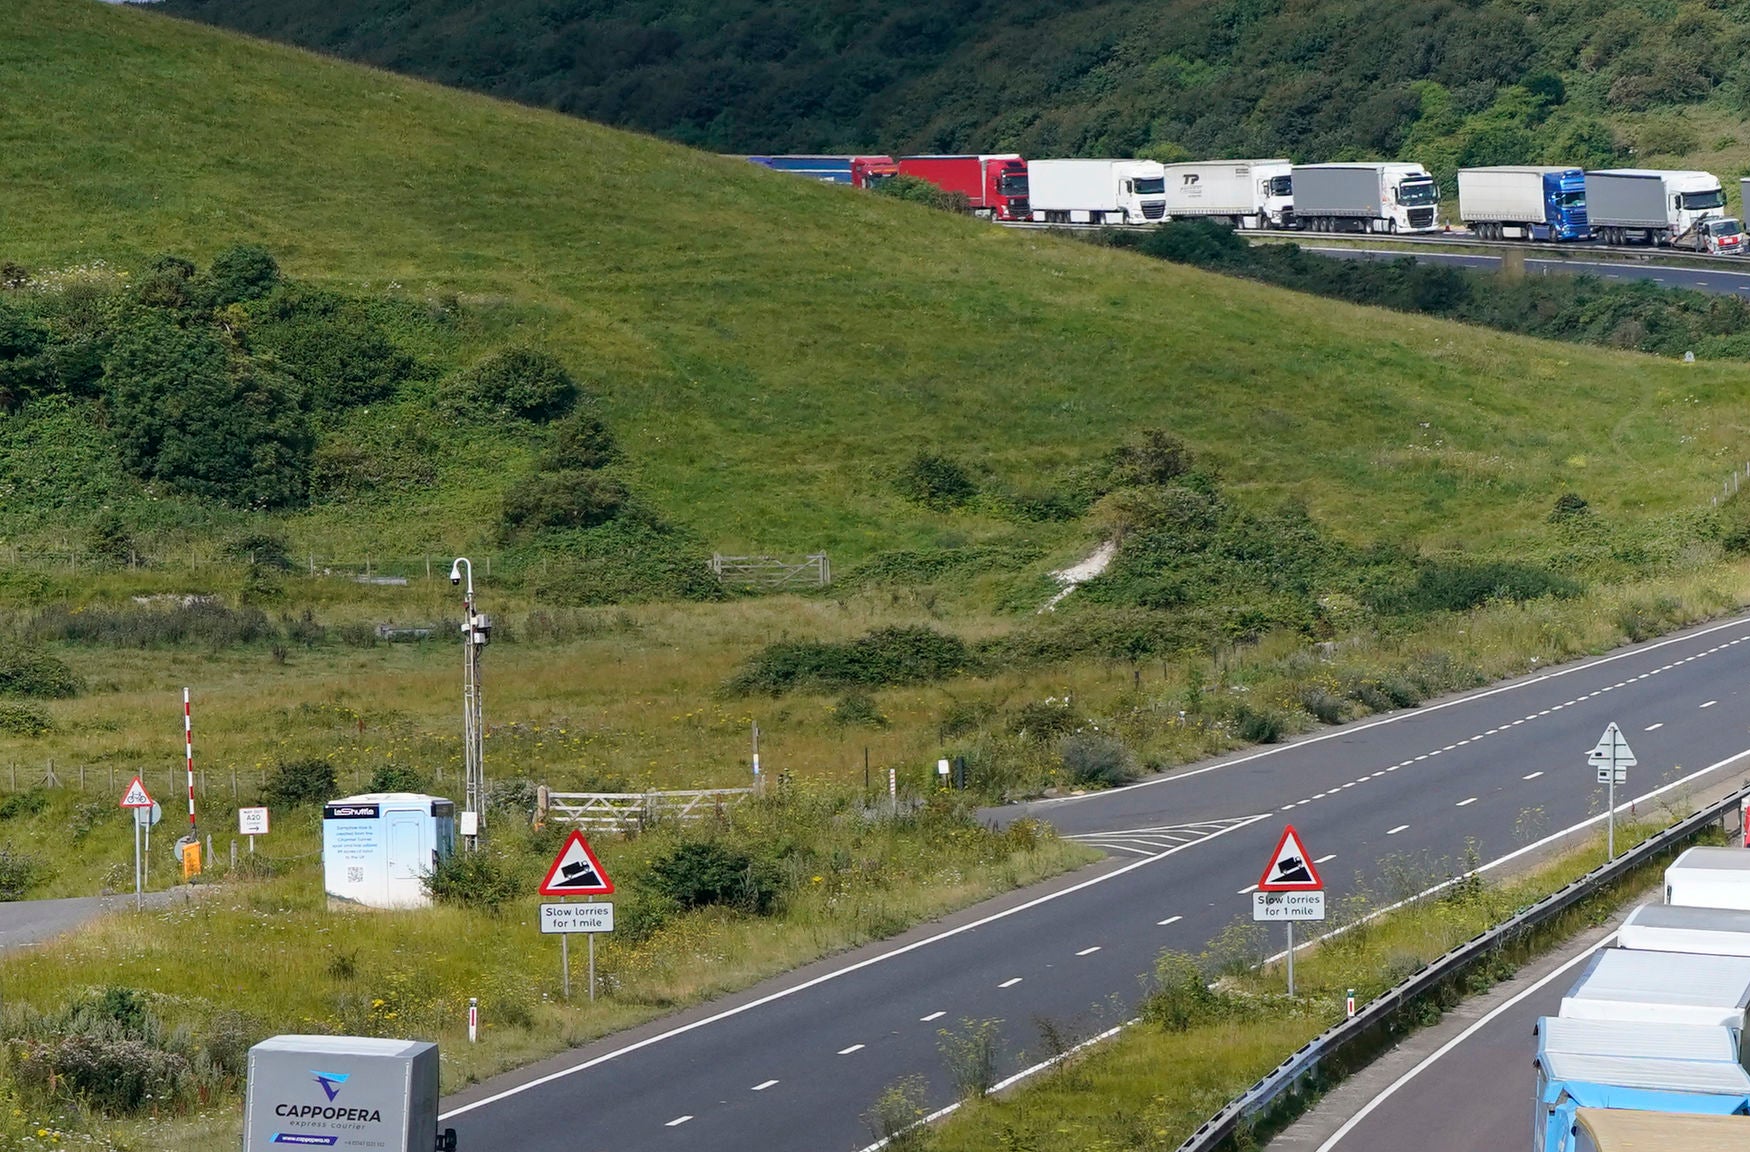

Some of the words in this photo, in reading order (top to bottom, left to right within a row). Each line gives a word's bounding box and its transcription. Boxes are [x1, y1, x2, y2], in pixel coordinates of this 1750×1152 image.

[1258, 895, 1283, 904] Slow
[1287, 895, 1320, 904] lorries
[545, 908, 572, 916] Slow
[575, 906, 609, 916] lorries
[1265, 907, 1279, 915] for
[1291, 907, 1313, 915] mile
[553, 919, 568, 927] for
[579, 919, 602, 927] mile
[275, 1103, 381, 1123] CAPPOPERA
[289, 1120, 327, 1128] express
[330, 1122, 366, 1130] courier
